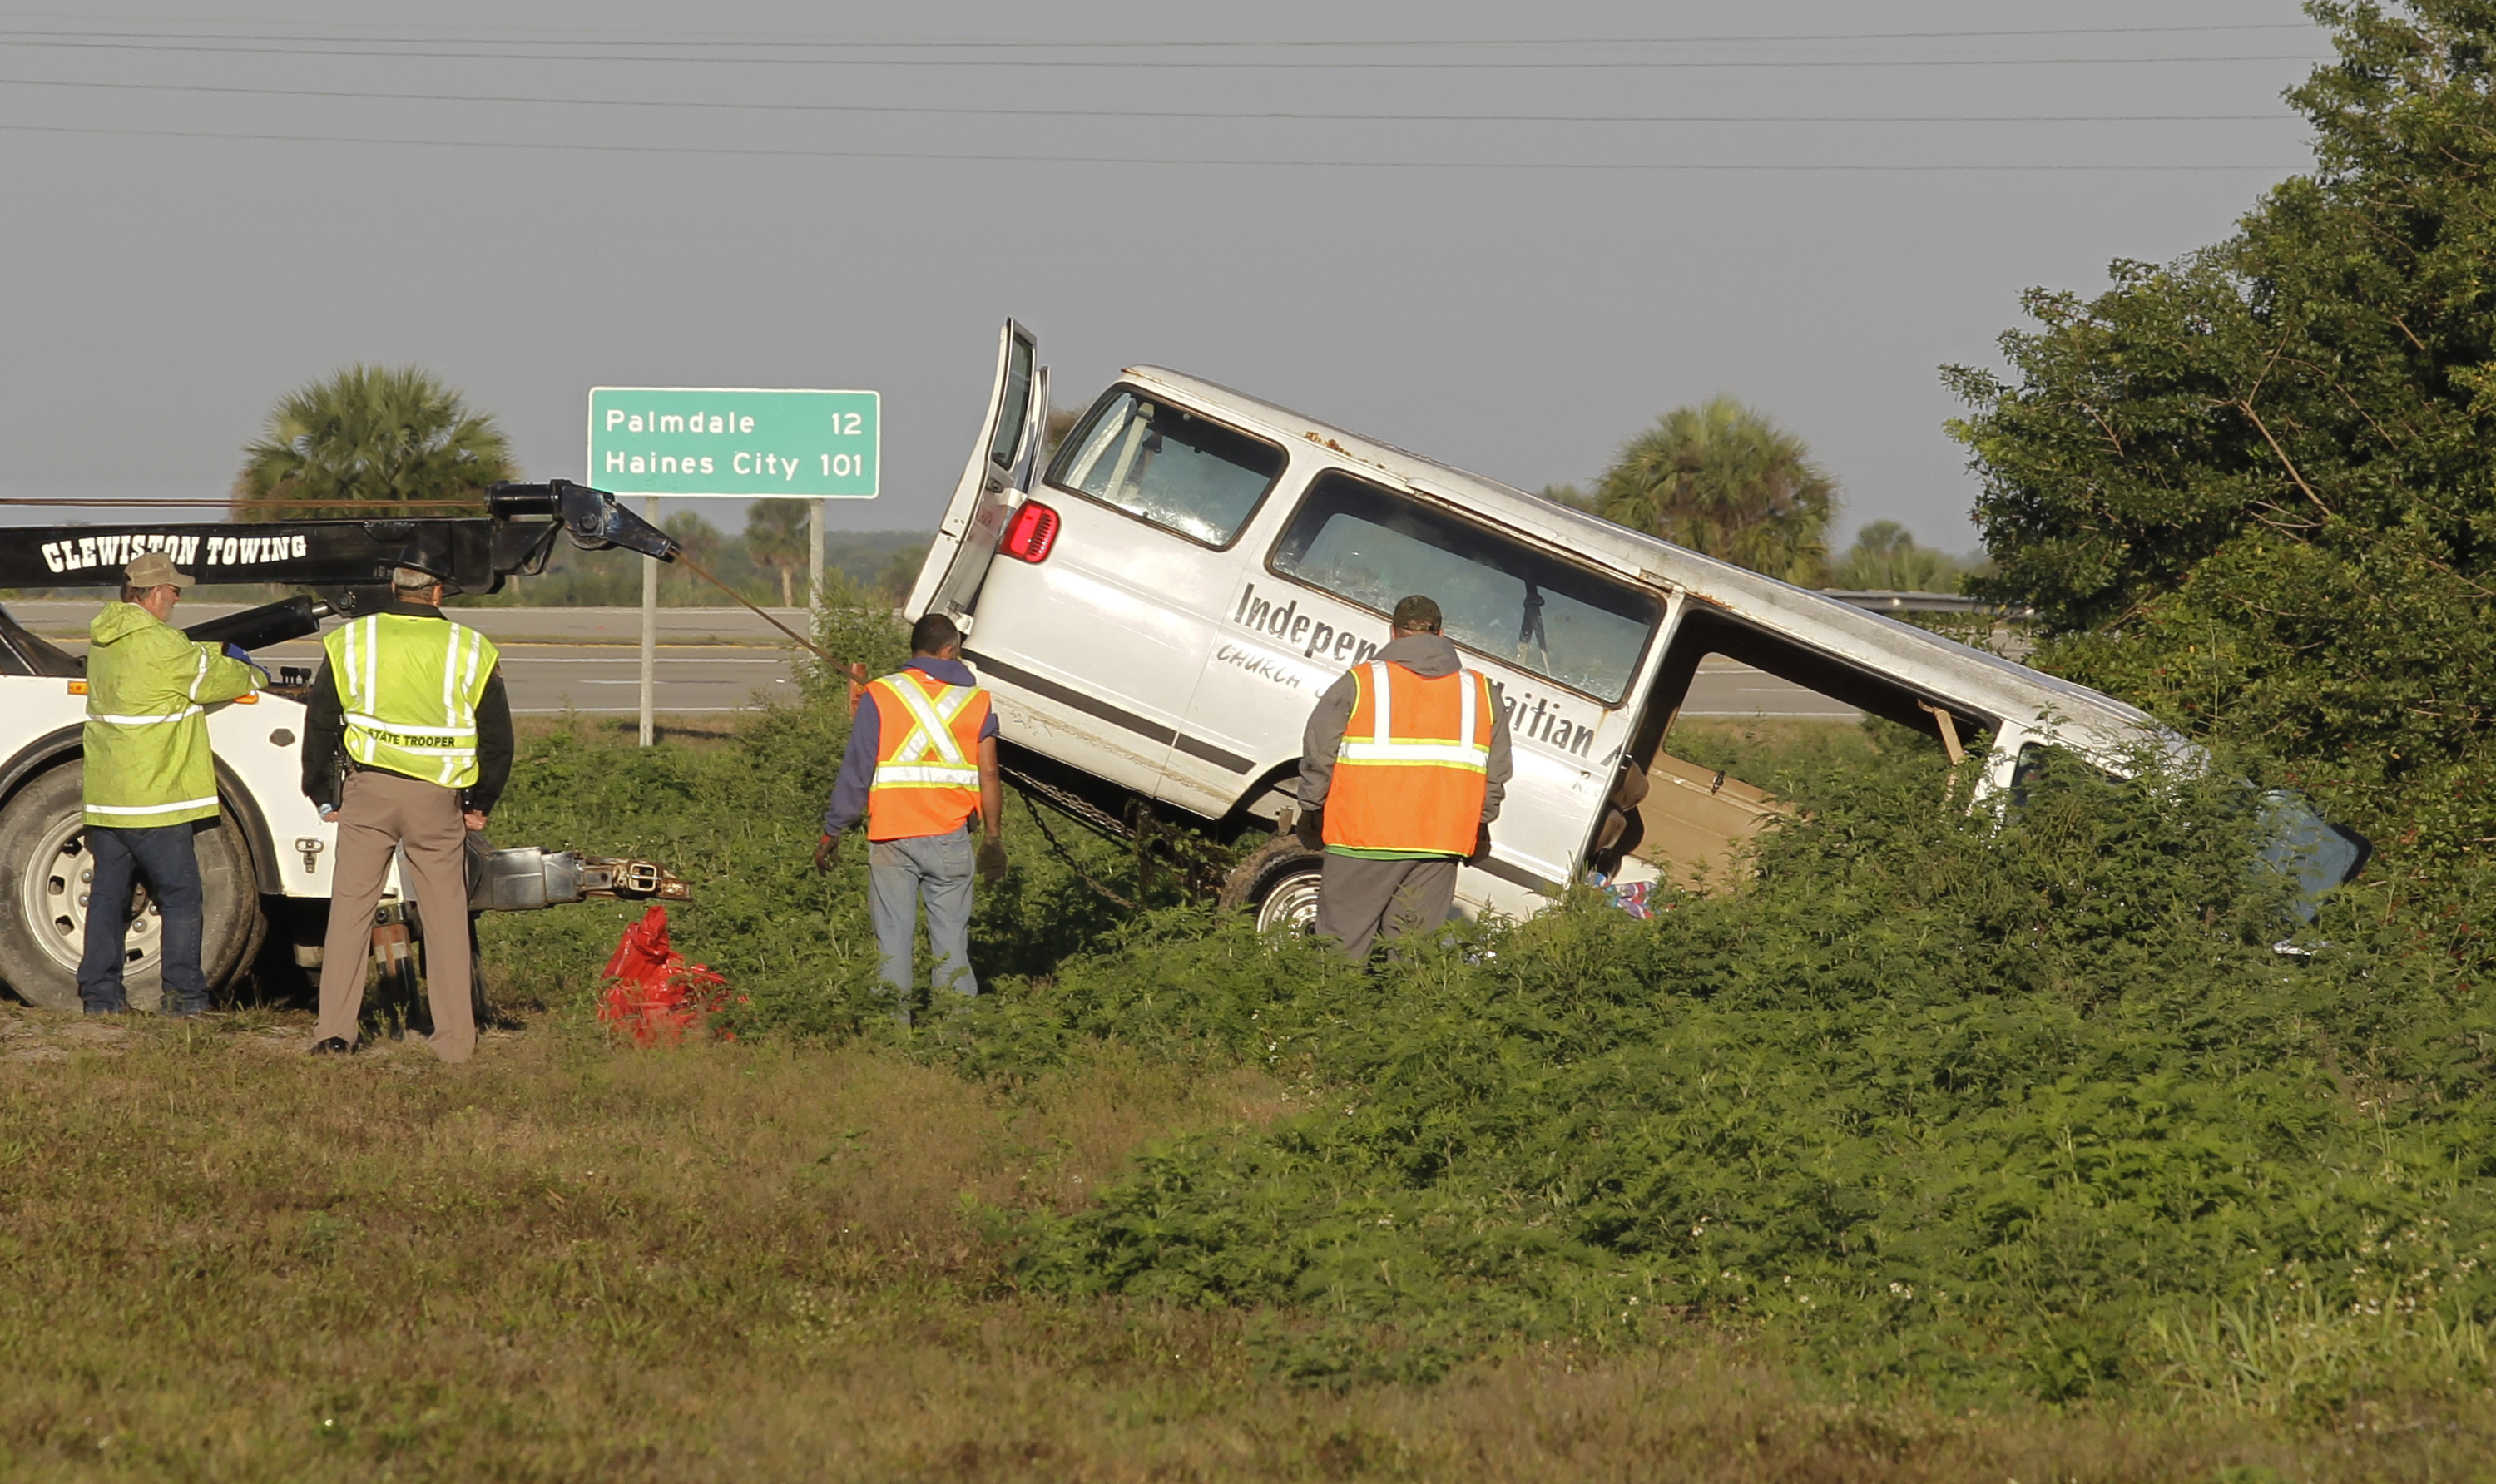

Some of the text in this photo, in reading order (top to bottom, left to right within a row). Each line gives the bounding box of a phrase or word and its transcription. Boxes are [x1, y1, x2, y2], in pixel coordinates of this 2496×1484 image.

[606, 409, 863, 435] Palmdale 12
[605, 451, 862, 481] Haines City 101
[41, 534, 308, 573] CLEWISTON TOWING
[1216, 644, 1303, 689] CHURCH
[1492, 679, 1595, 759] aitian
[368, 728, 455, 747] STATE TROOPER
